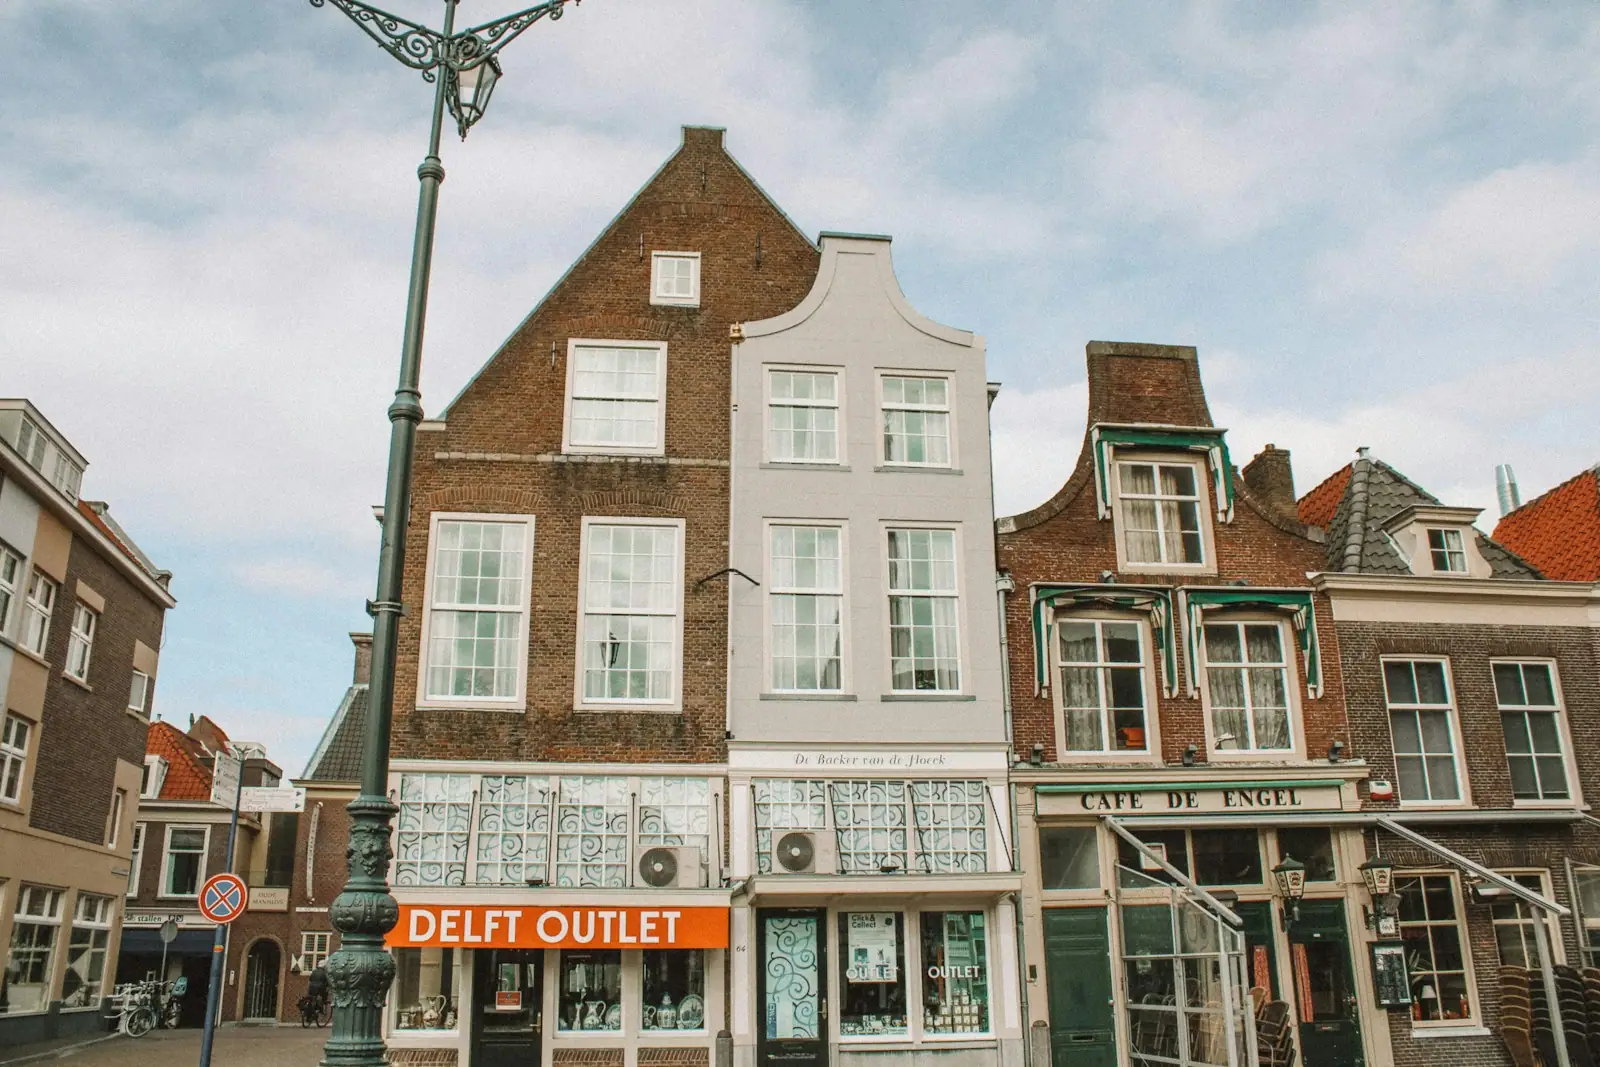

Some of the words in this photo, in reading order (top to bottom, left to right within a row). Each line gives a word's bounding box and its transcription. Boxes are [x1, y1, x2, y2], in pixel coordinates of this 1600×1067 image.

[795, 753, 809, 765] De
[863, 757, 884, 765] van
[889, 753, 902, 765] de
[1081, 791, 1143, 810] CAFE
[1167, 790, 1199, 809] DE
[1222, 788, 1302, 808] ENGEL
[409, 909, 522, 943] DELFT
[536, 910, 681, 944] OUTLET
[851, 921, 876, 929] Collect
[845, 966, 899, 981] OUTLET
[928, 965, 980, 979] OUTLET
